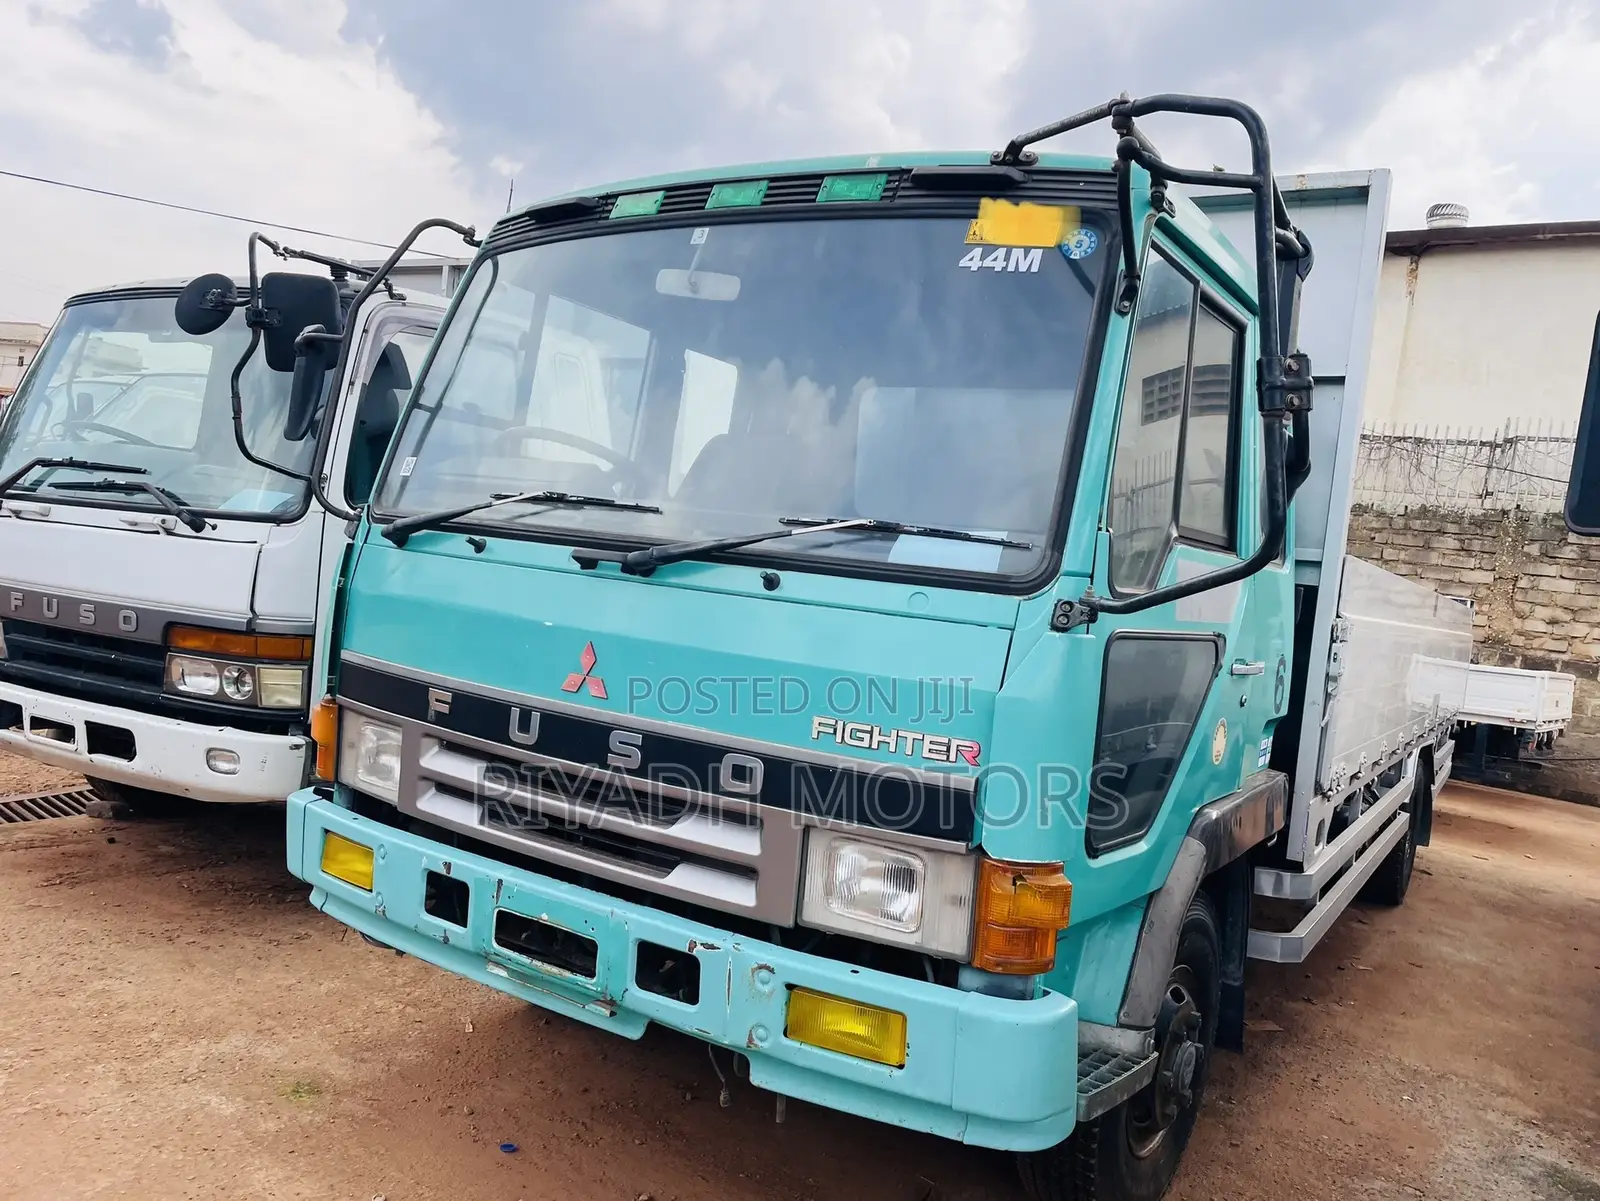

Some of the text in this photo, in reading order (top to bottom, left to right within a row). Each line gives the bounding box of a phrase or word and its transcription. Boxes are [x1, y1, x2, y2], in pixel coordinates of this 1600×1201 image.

[958, 247, 1044, 273] 44M
[10, 591, 139, 633] FUSO
[1273, 656, 1287, 715] 6
[428, 687, 764, 795] FUSO
[810, 715, 981, 767] FIGHTER
